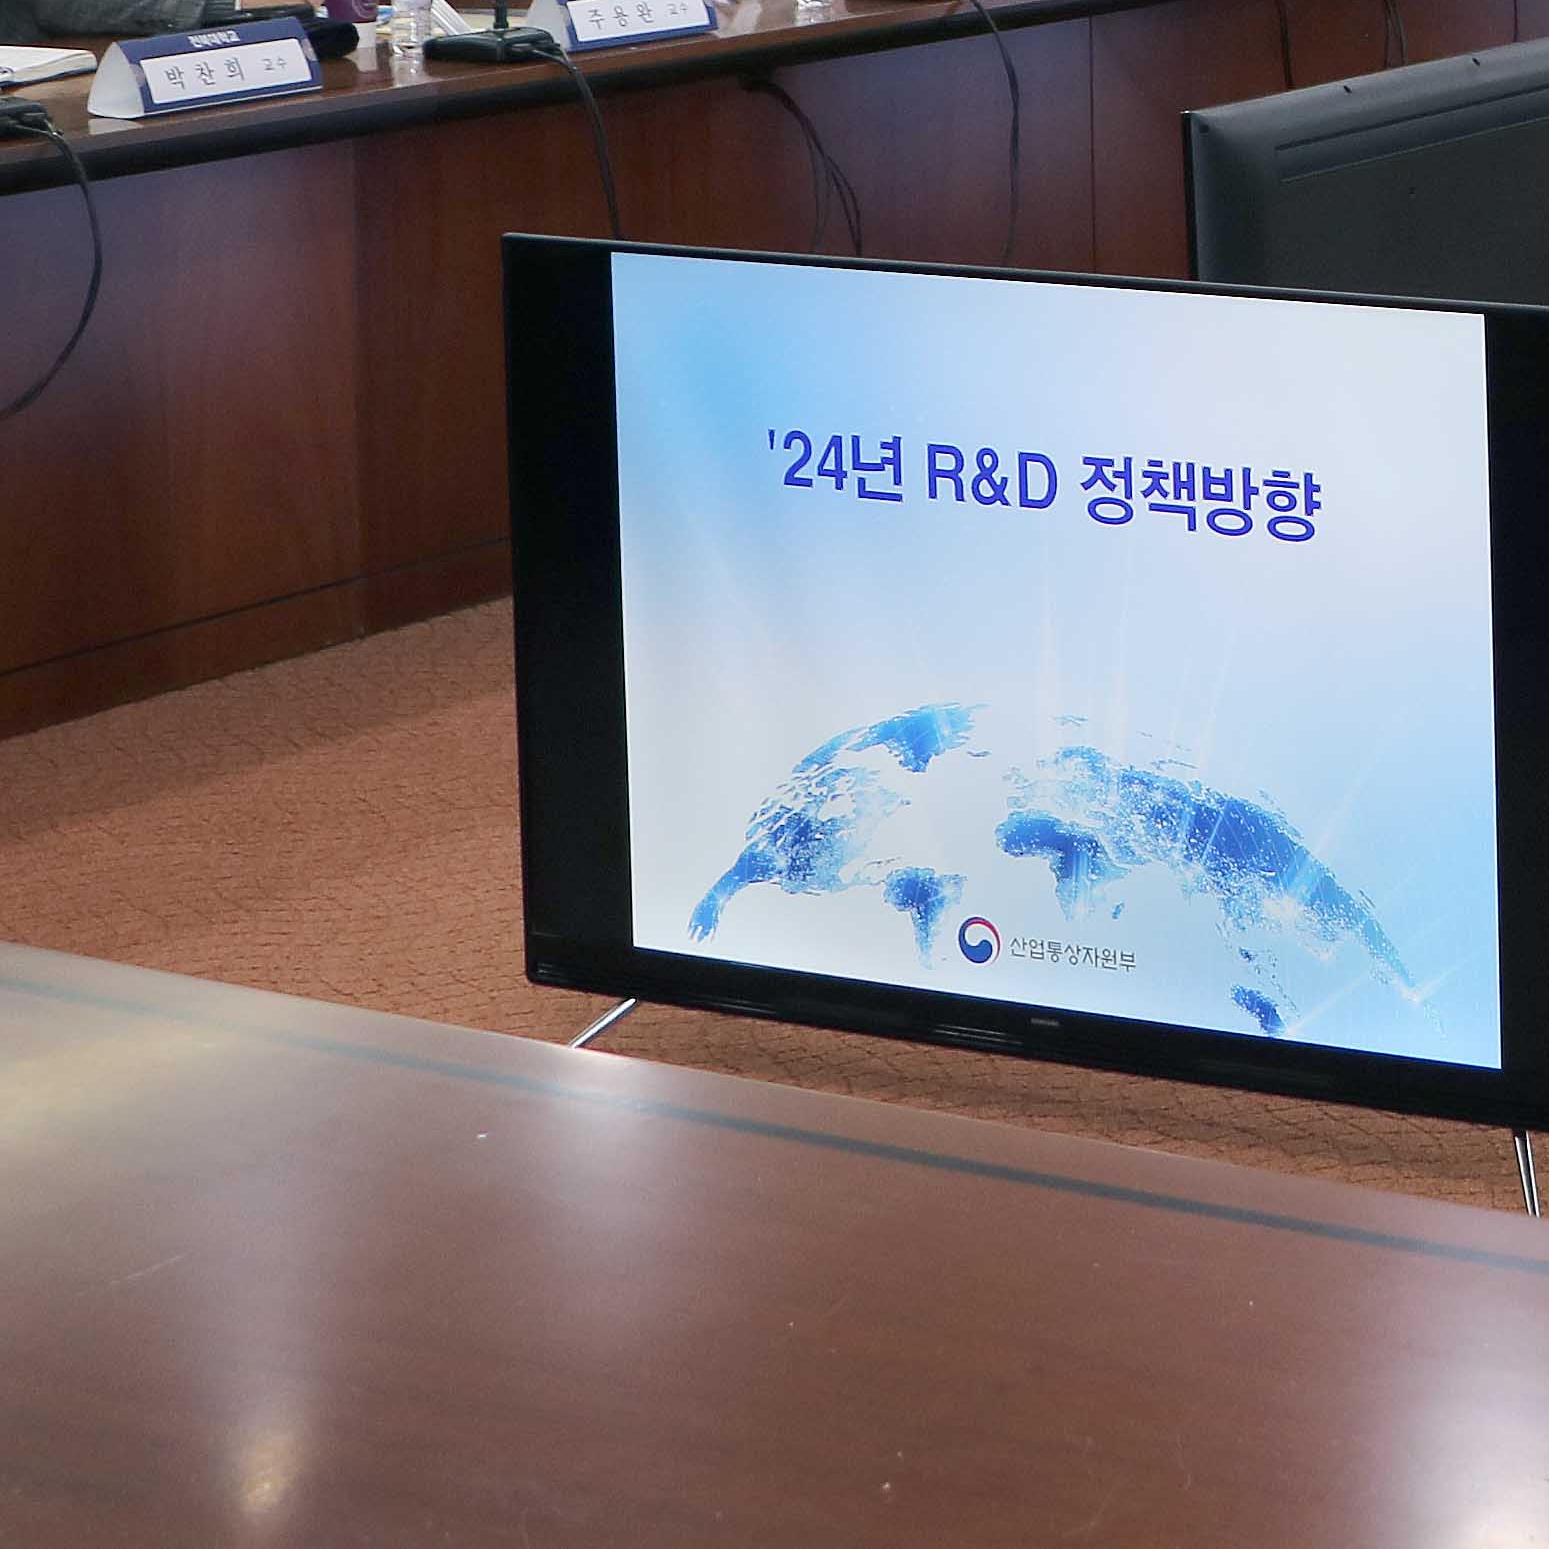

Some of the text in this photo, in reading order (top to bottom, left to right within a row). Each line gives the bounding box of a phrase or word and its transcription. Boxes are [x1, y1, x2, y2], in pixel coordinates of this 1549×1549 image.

[767, 429, 1323, 542] '24년 R&D 정책방향
[1008, 934, 1138, 973] 산업통상자원부
